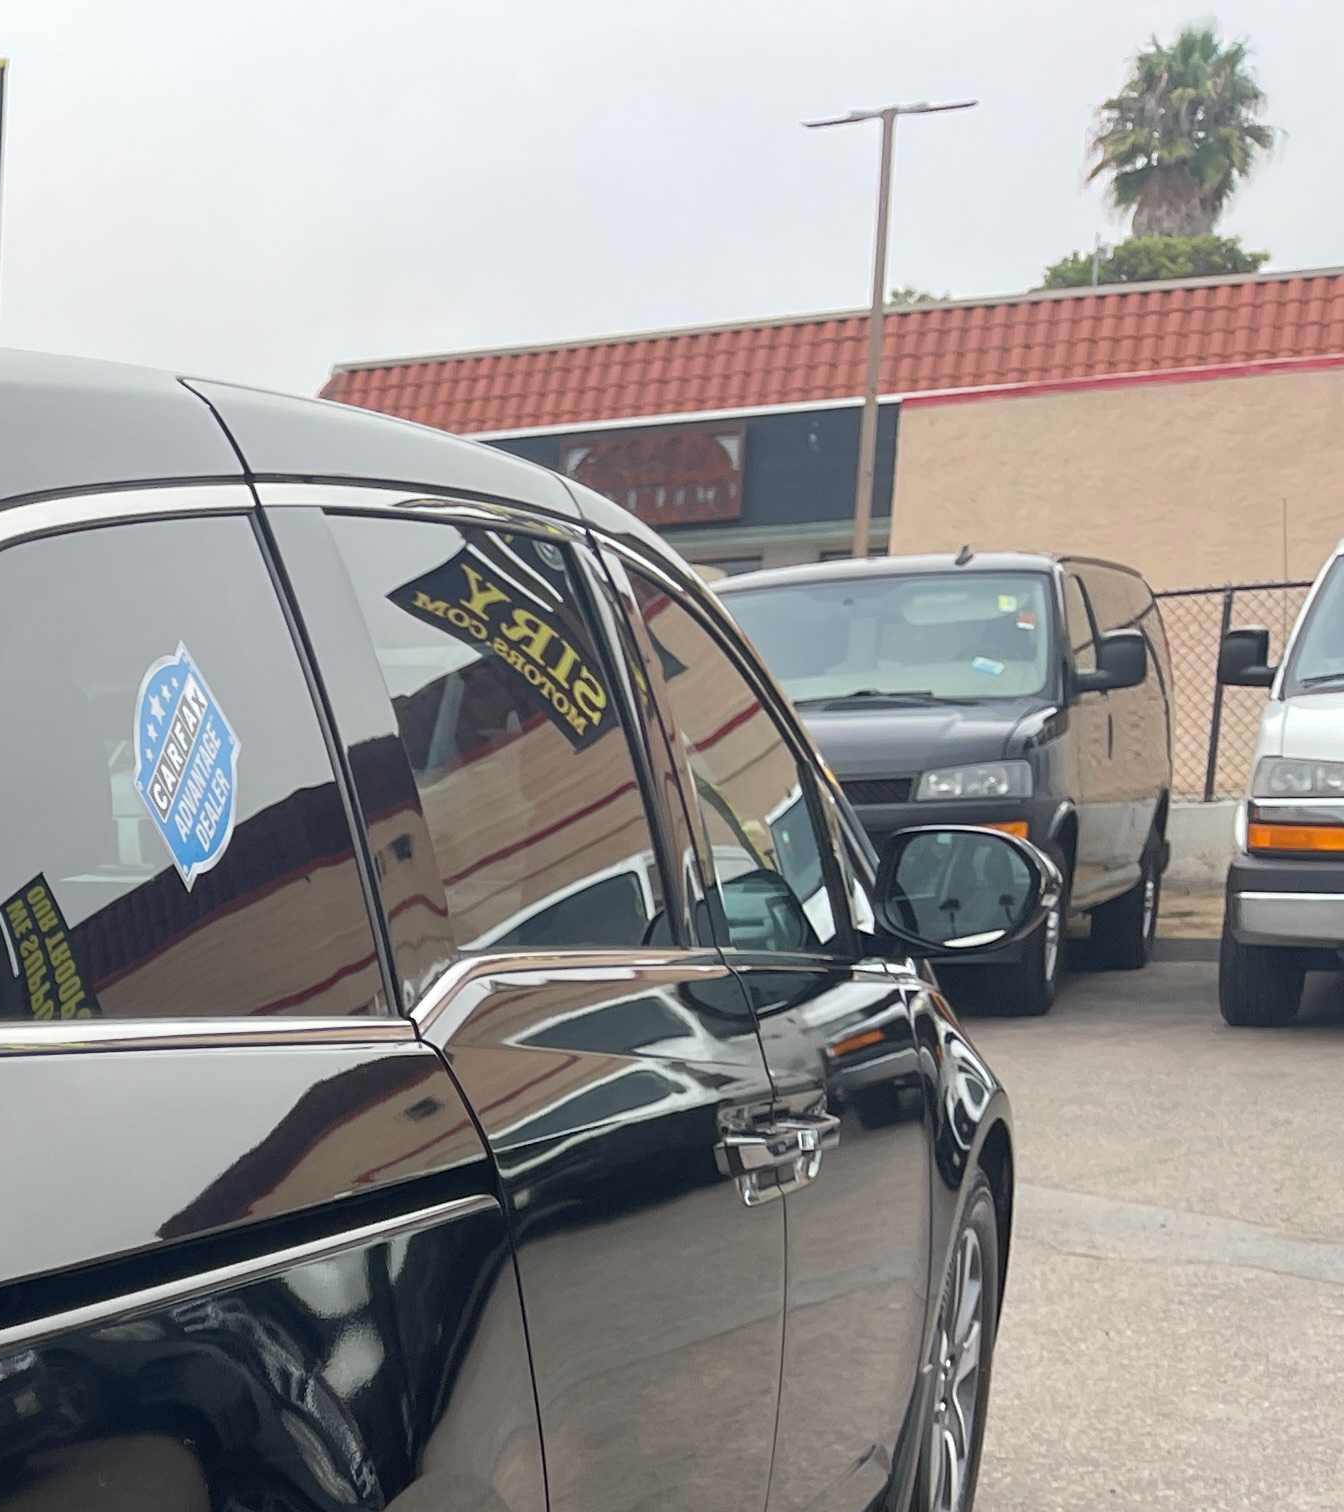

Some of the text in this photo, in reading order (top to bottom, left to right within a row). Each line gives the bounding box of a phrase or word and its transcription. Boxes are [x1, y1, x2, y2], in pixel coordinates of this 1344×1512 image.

[150, 684, 207, 814] CARFAX
[174, 722, 222, 844] ADVANTAGE
[195, 766, 231, 853] DEALER
